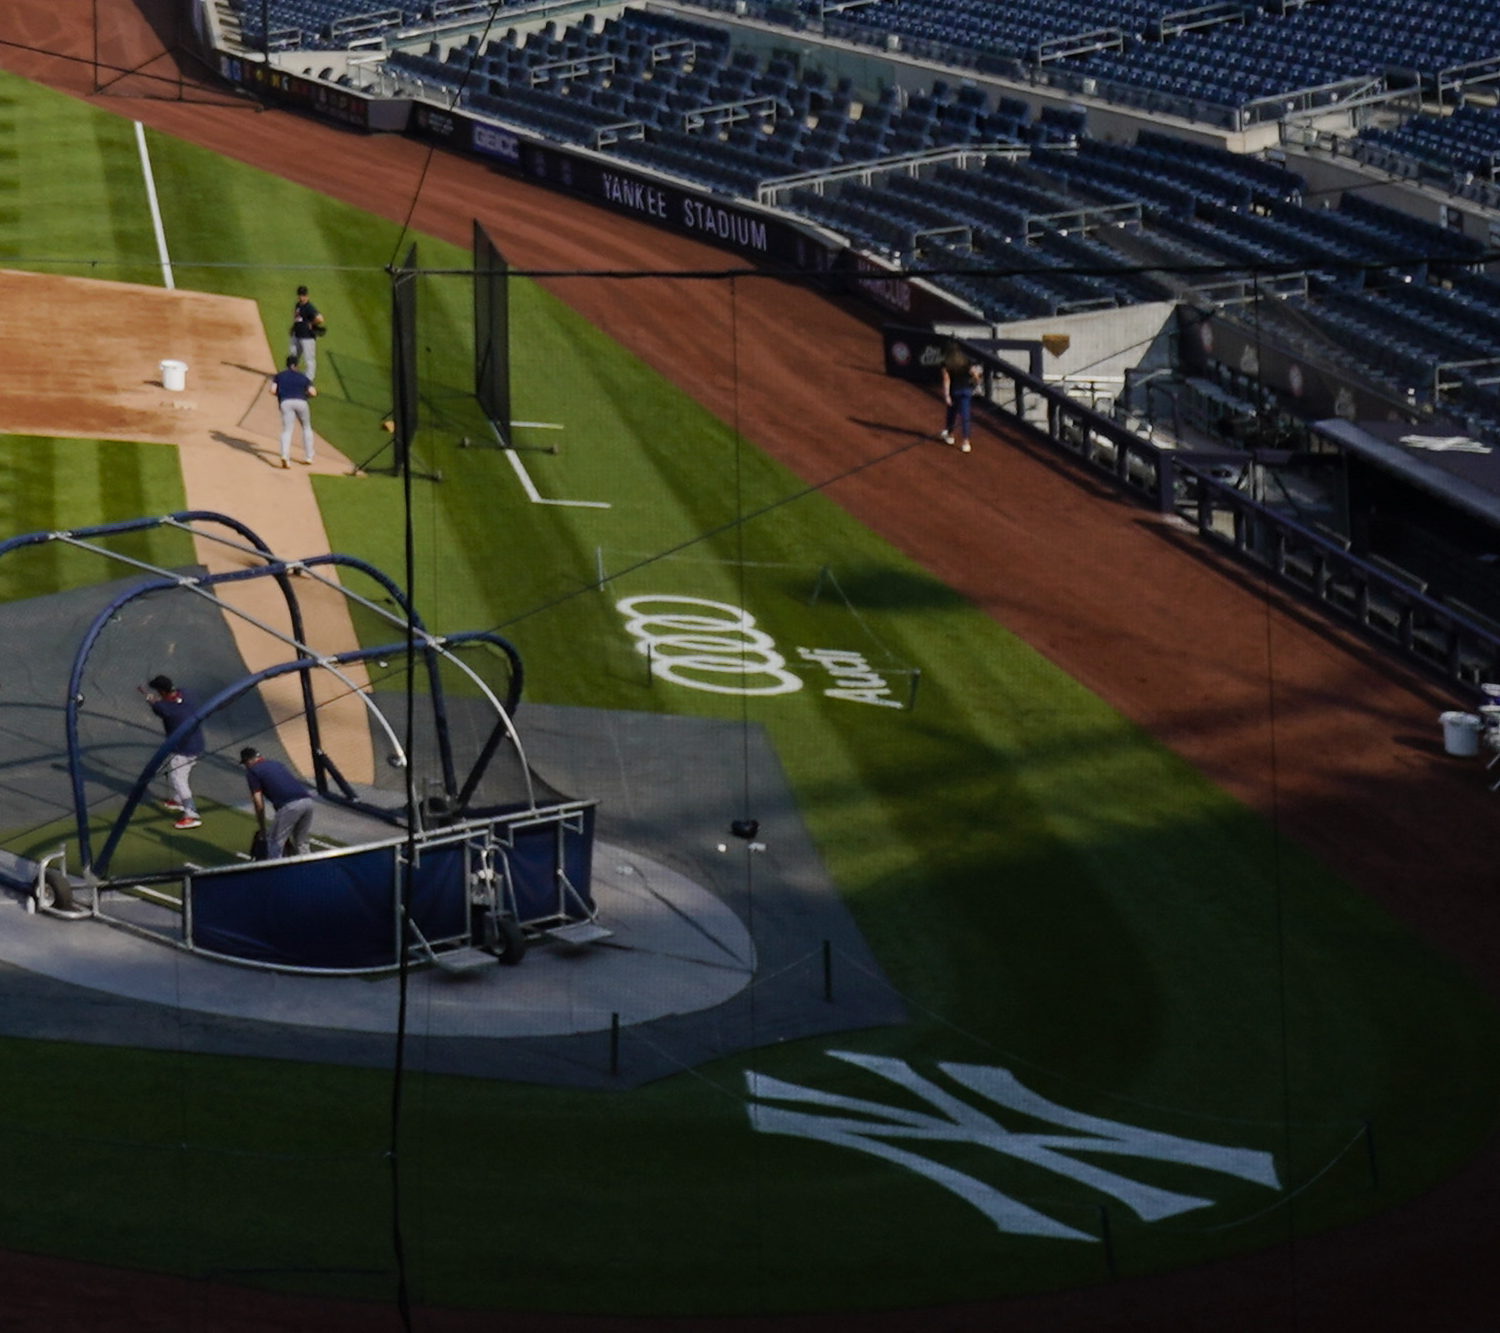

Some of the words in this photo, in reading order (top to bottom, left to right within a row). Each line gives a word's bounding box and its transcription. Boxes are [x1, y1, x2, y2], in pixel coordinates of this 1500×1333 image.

[603, 173, 668, 221] YANKEE
[684, 200, 768, 253] STADIUM
[825, 650, 904, 709] Audi
